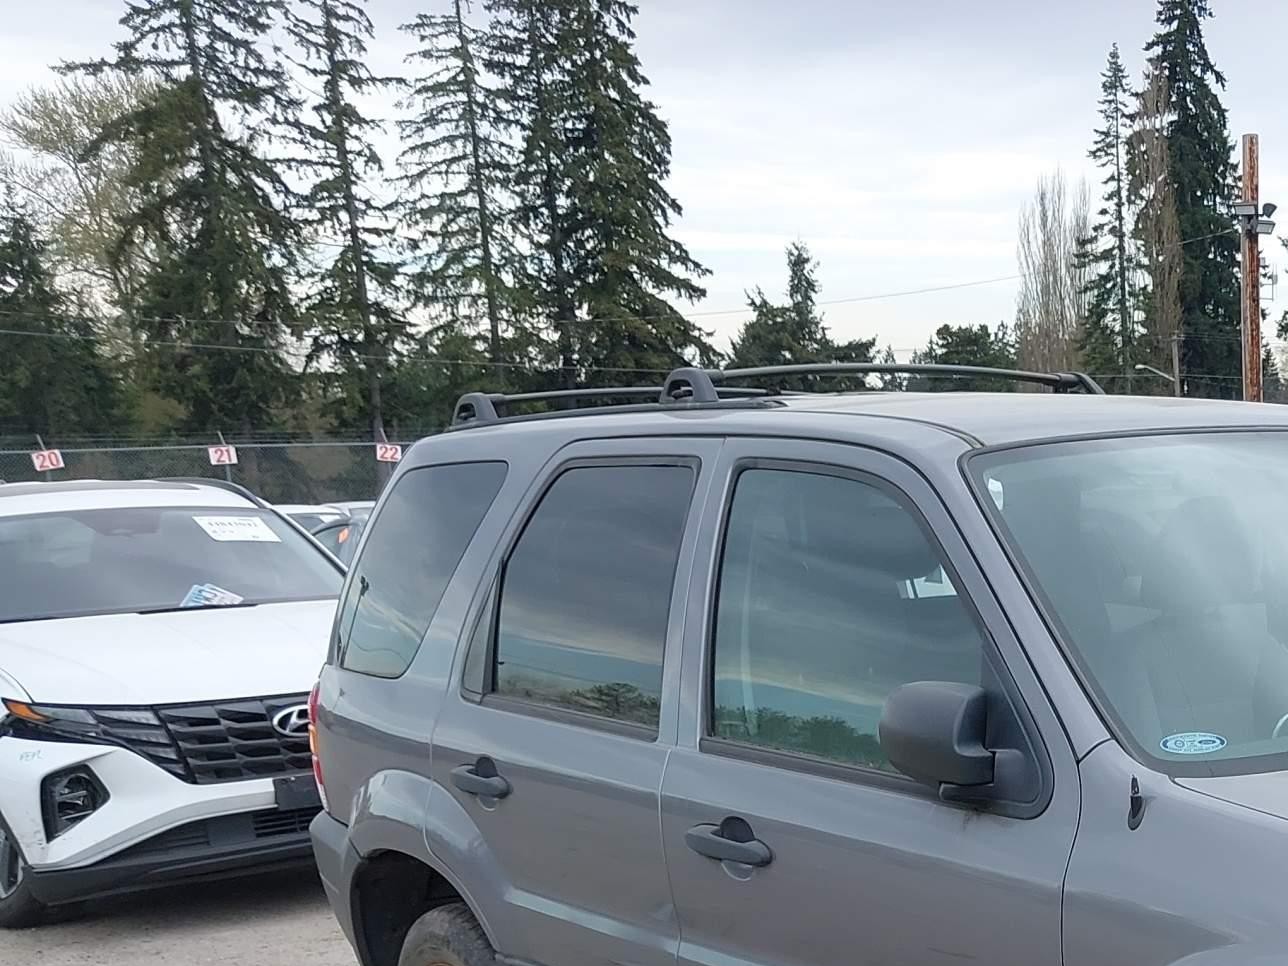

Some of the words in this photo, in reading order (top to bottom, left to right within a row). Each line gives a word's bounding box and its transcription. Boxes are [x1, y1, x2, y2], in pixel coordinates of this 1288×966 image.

[36, 451, 60, 468] 20
[214, 448, 232, 463] 21
[379, 445, 399, 460] 22
